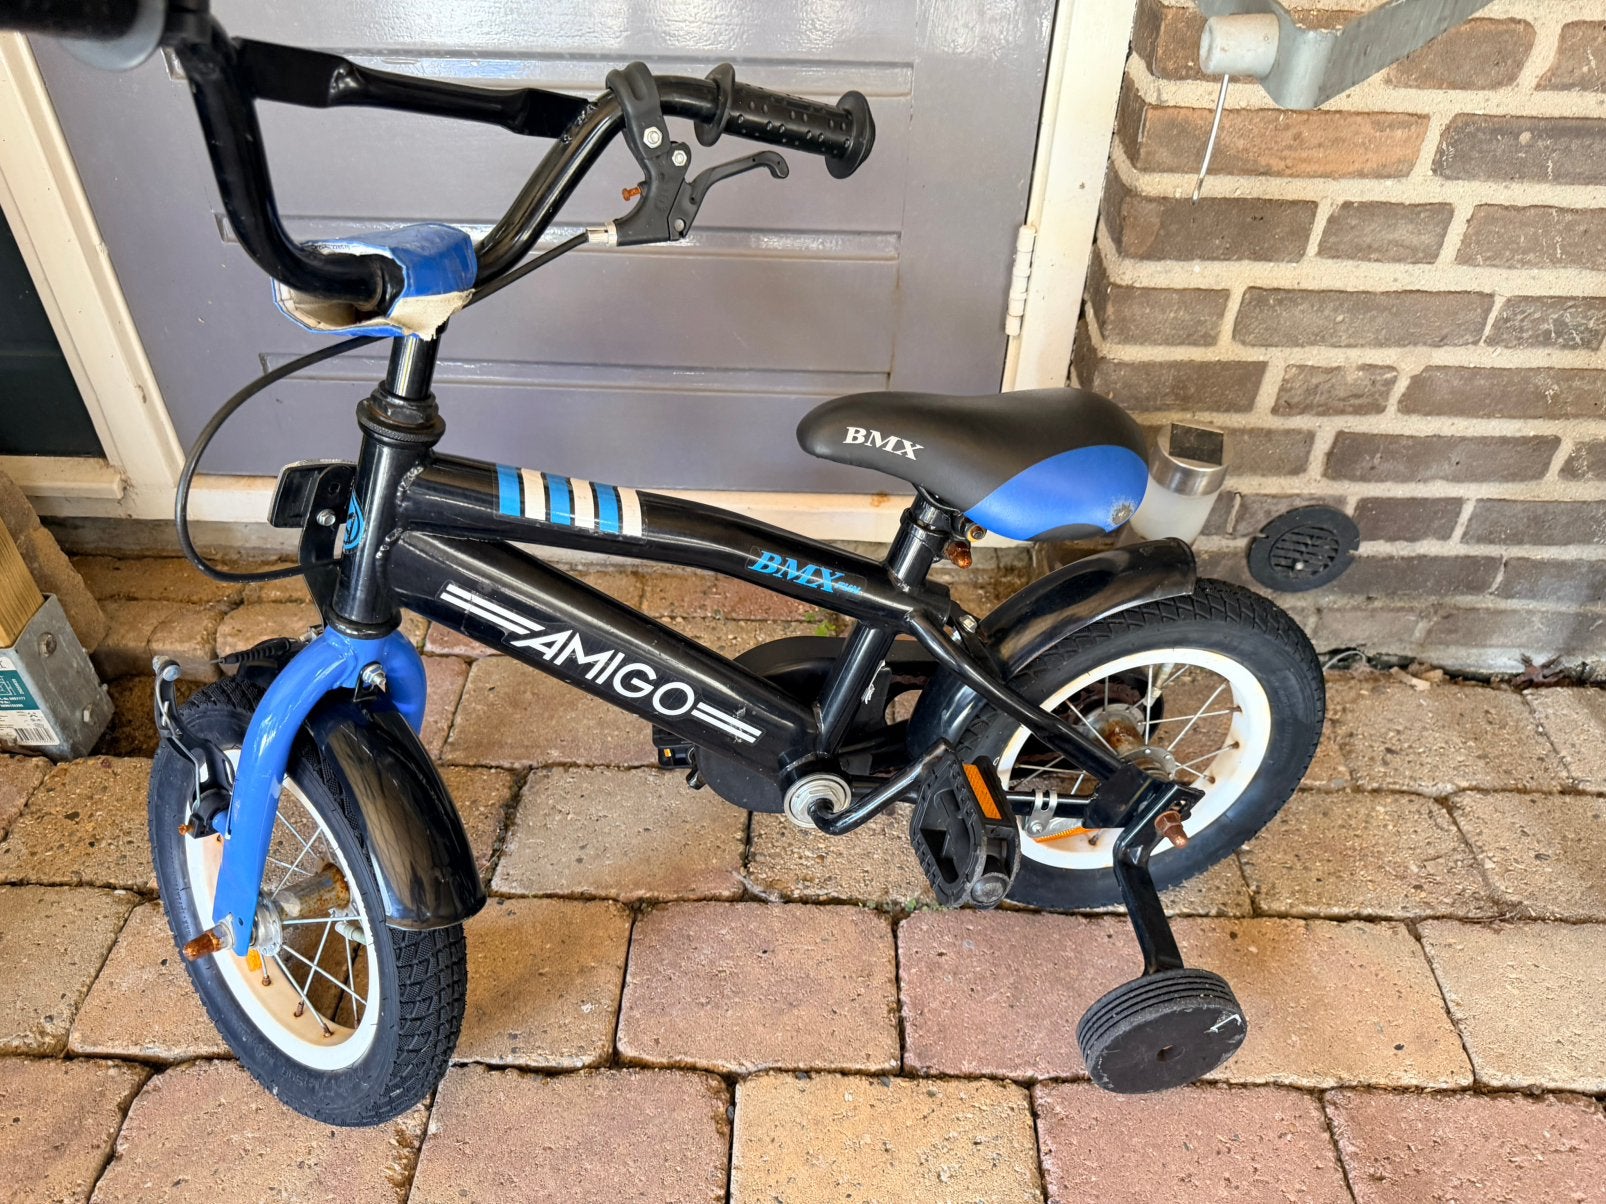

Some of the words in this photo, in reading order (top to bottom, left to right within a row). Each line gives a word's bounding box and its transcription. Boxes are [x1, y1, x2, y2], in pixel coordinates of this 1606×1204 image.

[843, 426, 924, 460] BMX
[748, 551, 845, 592] BMX
[510, 630, 695, 716] AMIGO
